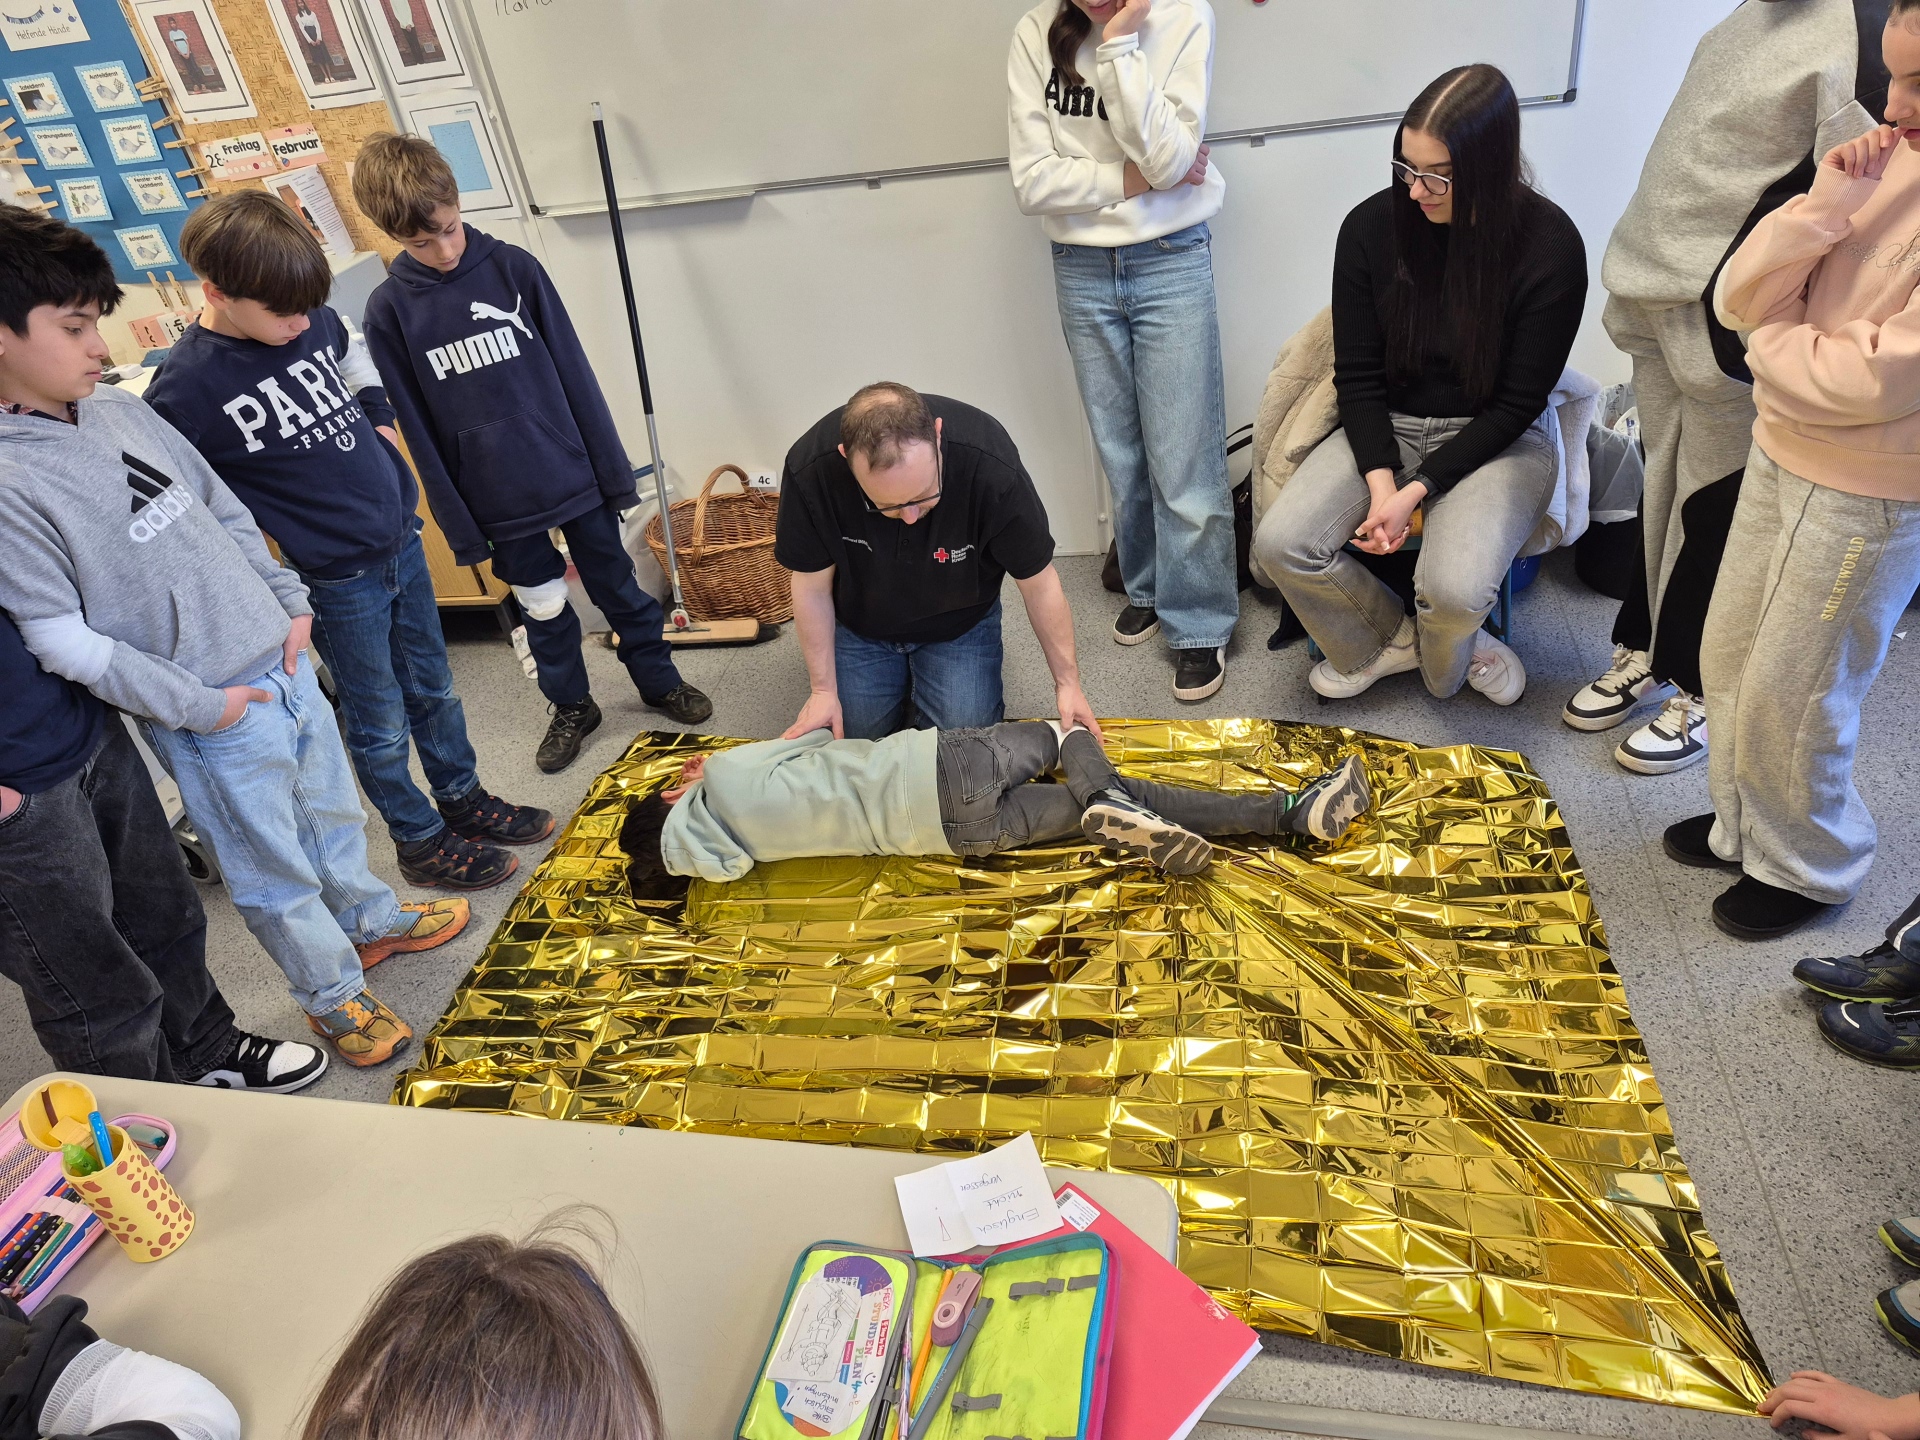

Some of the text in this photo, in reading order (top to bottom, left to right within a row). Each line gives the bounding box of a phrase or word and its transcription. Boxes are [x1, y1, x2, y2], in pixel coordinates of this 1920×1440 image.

[15, 27, 47, 40] Helfende
[36, 132, 74, 141] Ordnungsdienst
[112, 124, 142, 133] Datumsdienst
[222, 140, 261, 155] Freitag
[272, 138, 319, 156] Februar
[425, 325, 521, 381] PUMA
[129, 485, 194, 543] adidas
[1820, 536, 1866, 621] SMILEYWORLD
[985, 1189, 1023, 1210] nicht
[976, 1207, 1040, 1234] Englisch
[882, 1287, 892, 1312] FREYA
[852, 1347, 864, 1379] PLAN
[812, 1411, 832, 1424] Bitte
